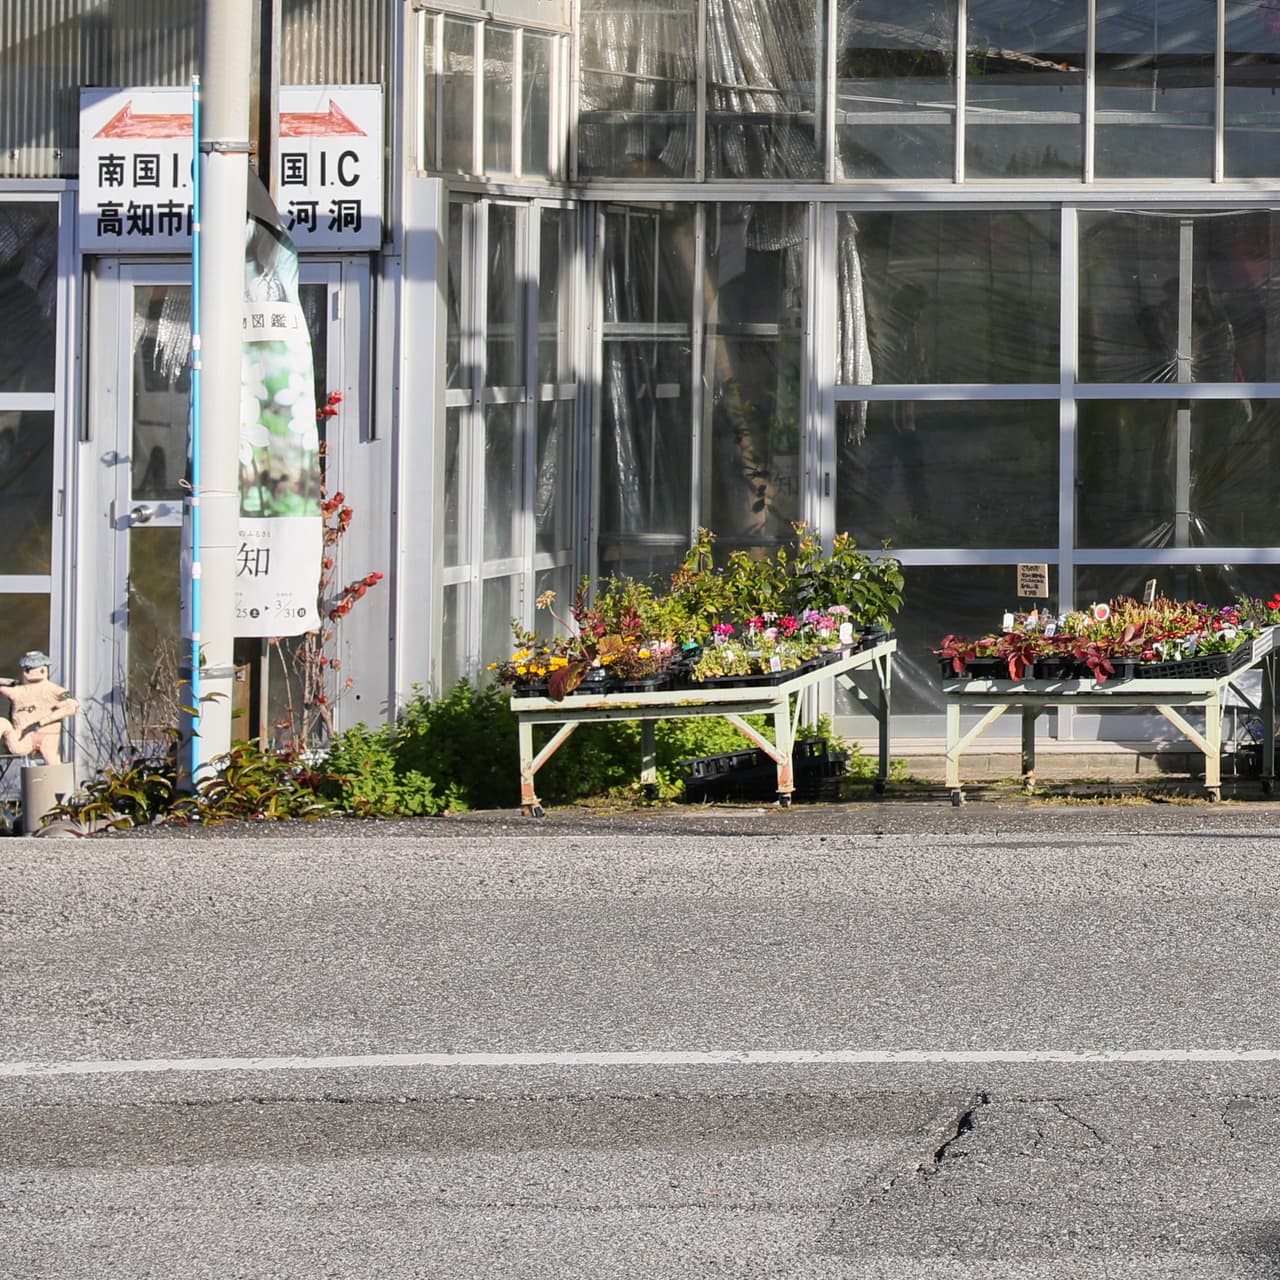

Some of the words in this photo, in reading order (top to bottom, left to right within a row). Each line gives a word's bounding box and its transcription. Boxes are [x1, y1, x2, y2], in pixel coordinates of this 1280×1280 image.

[98, 152, 194, 188] 南国I.
[97, 199, 193, 236] 高知市
